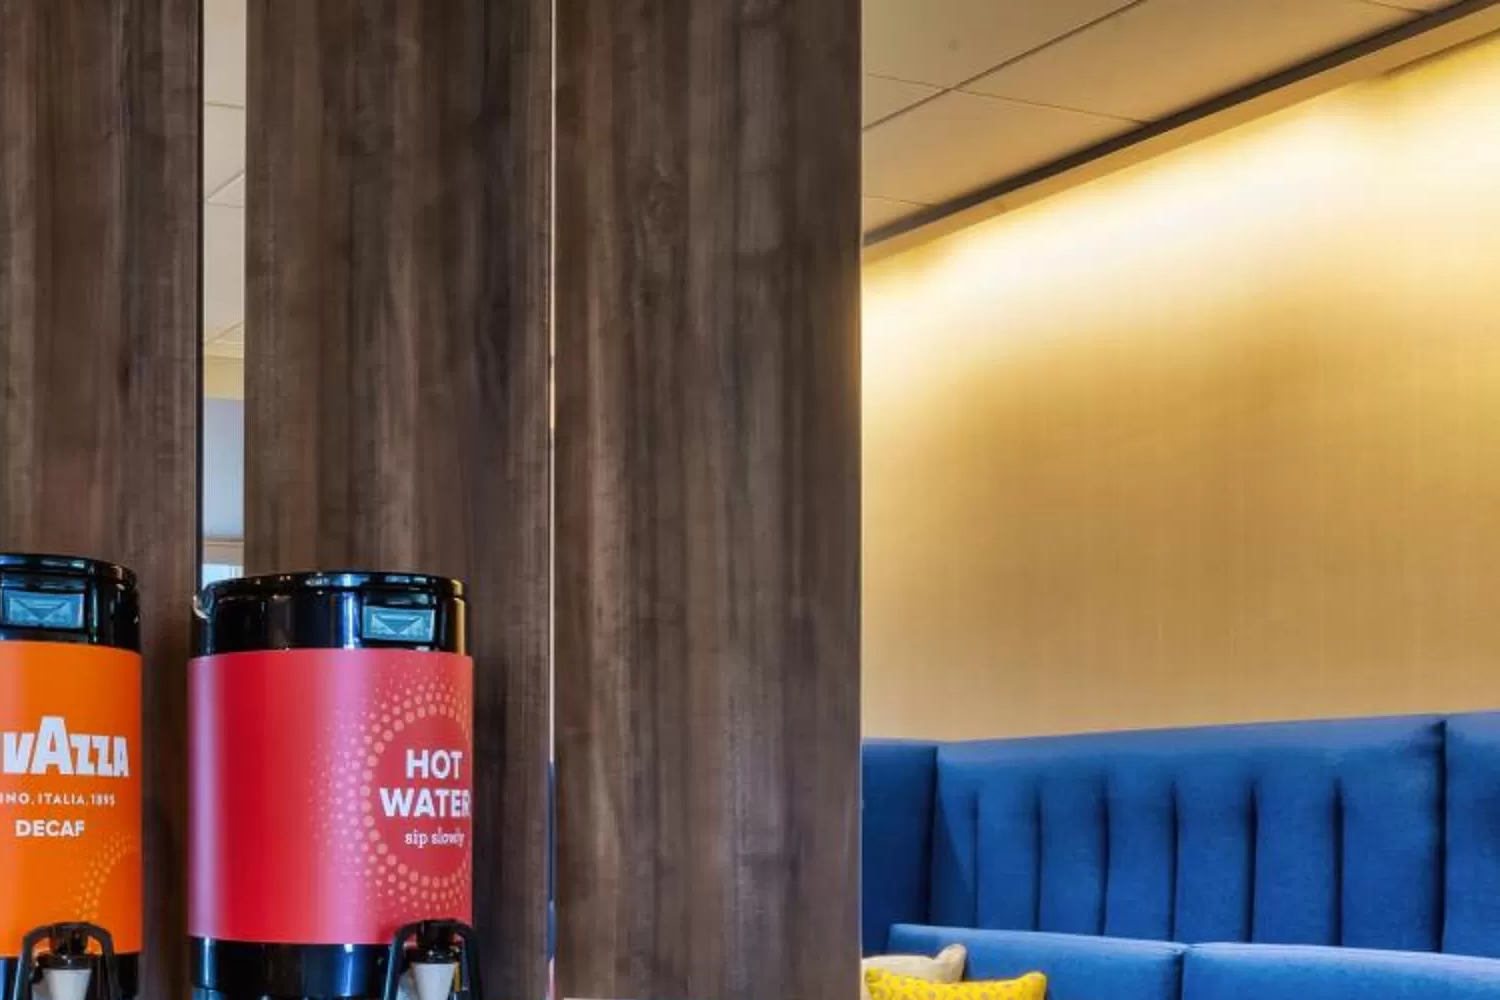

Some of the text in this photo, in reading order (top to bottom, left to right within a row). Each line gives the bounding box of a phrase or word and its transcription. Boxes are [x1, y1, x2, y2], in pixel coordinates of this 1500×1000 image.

[406, 749, 463, 779] HOT
[379, 787, 471, 817] WATER
[15, 819, 85, 837] DECAF
[404, 828, 427, 848] sip
